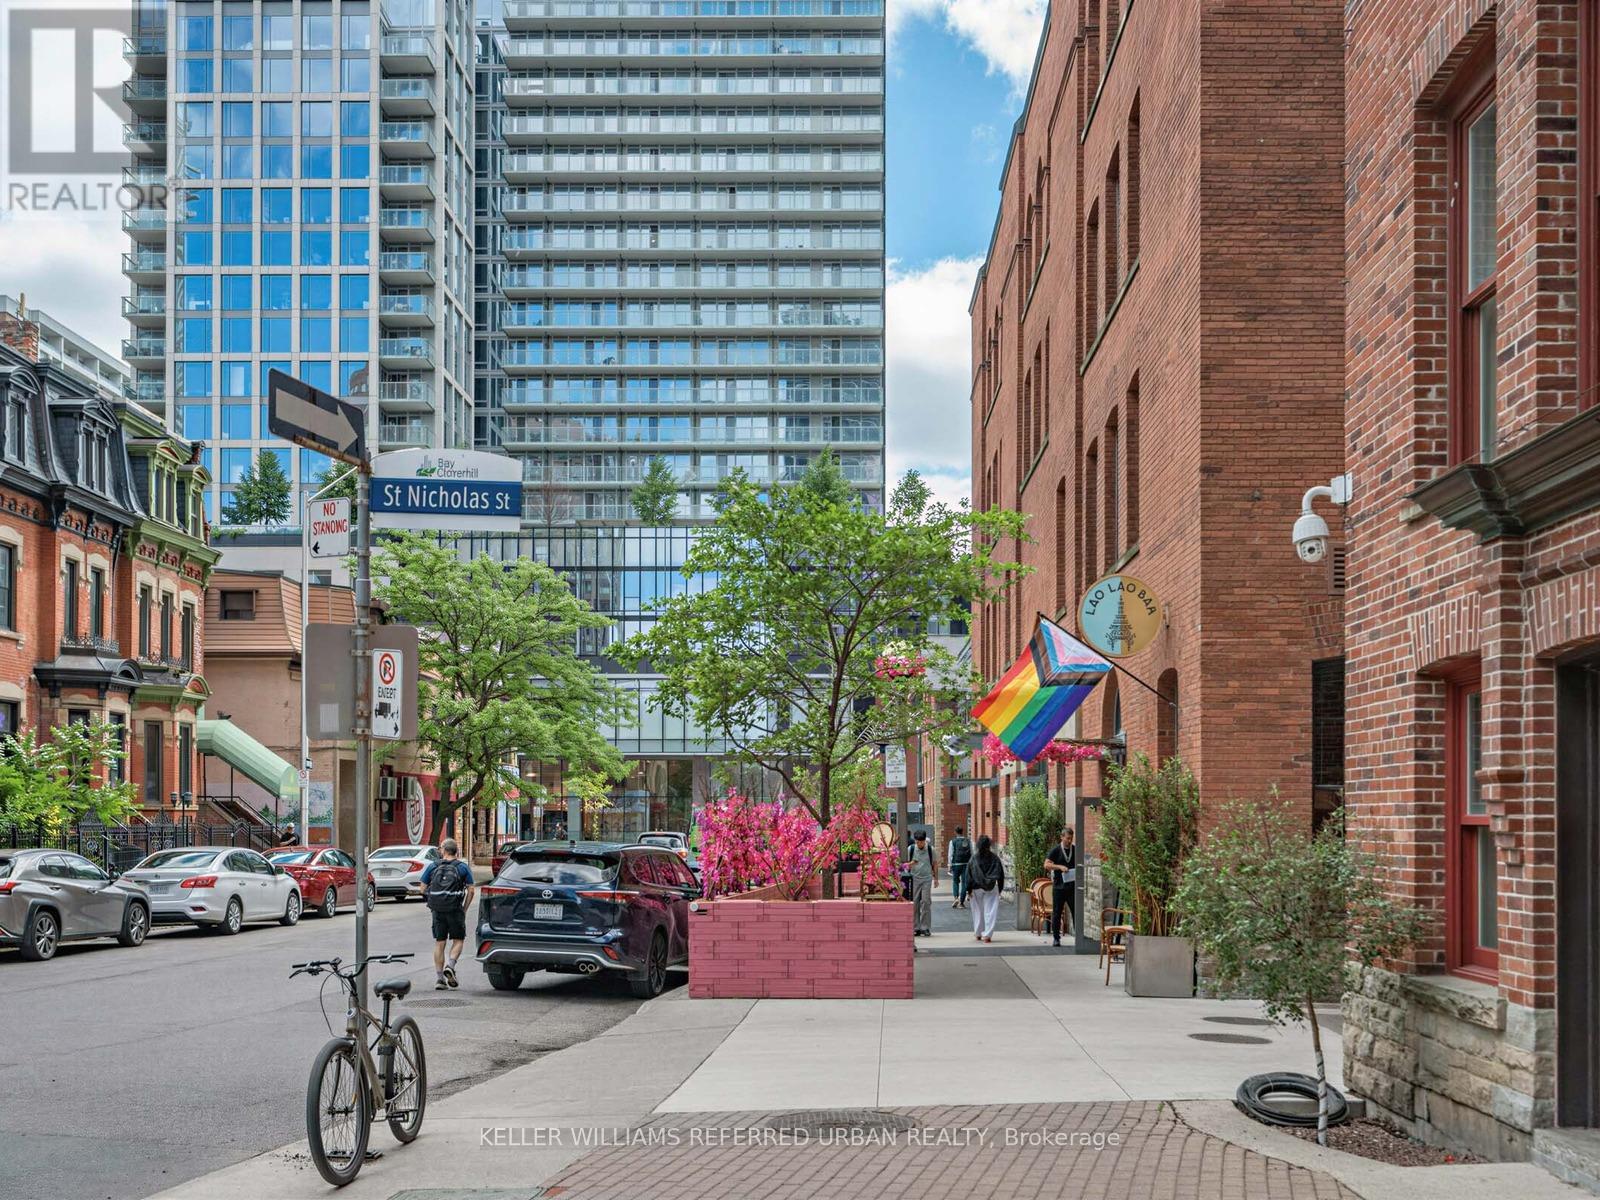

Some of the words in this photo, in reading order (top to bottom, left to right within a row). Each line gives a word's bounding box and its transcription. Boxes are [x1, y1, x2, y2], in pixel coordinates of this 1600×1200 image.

[438, 458, 455, 469] Bay
[383, 484, 402, 507] St
[407, 485, 490, 510] Nicholas
[495, 492, 511, 510] St
[323, 502, 336, 516] NO
[313, 519, 348, 536] STANDING
[1085, 589, 1105, 616] LAO
[1107, 580, 1137, 593] LAO
